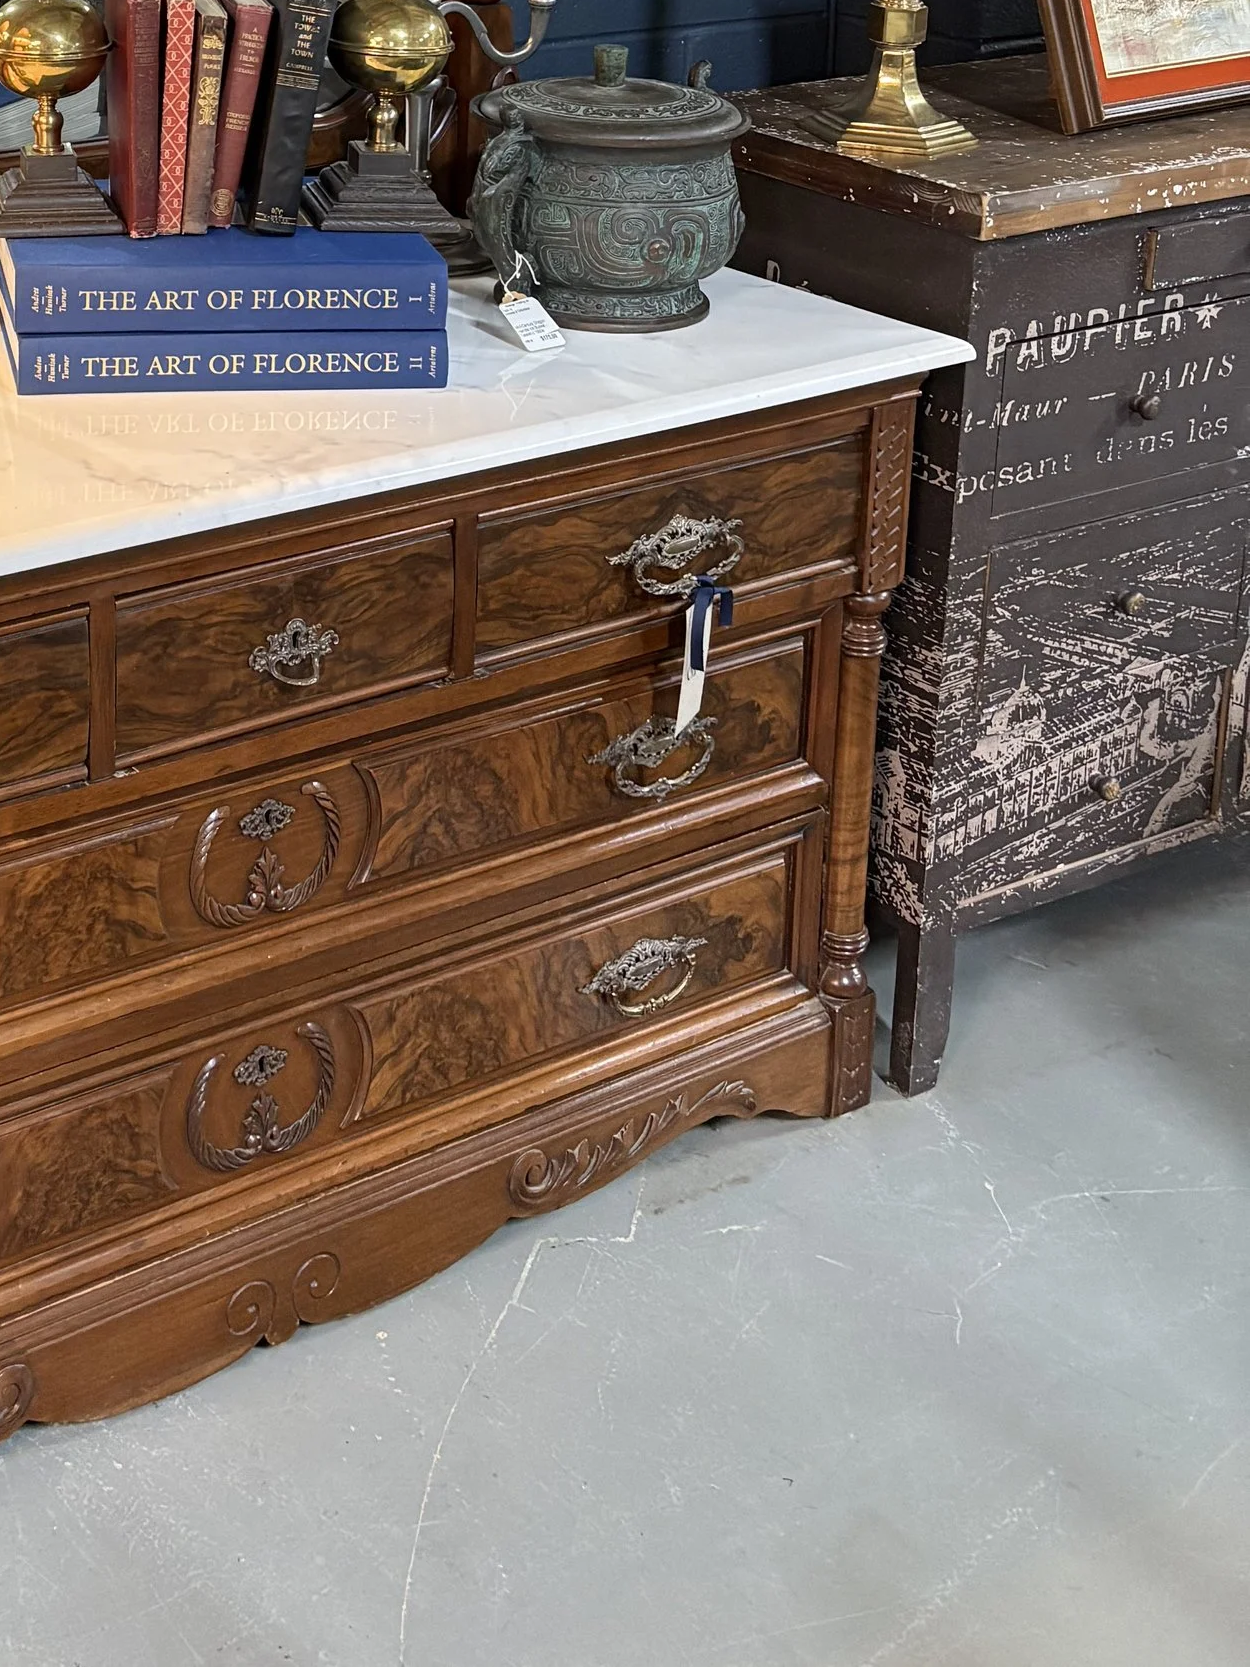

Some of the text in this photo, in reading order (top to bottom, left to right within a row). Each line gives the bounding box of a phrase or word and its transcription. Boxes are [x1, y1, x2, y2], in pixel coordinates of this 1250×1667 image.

[301, 14, 317, 24] THE
[290, 48, 314, 59] TOWN
[296, 40, 311, 50] THE
[59, 287, 69, 313] Turner
[78, 288, 400, 311] THE ART OF FLORENCE
[985, 293, 1187, 377] PAUPIER
[62, 354, 71, 380] Turner
[80, 352, 400, 377] THE ART OF FLORENCE
[1136, 352, 1236, 396] PARIS
